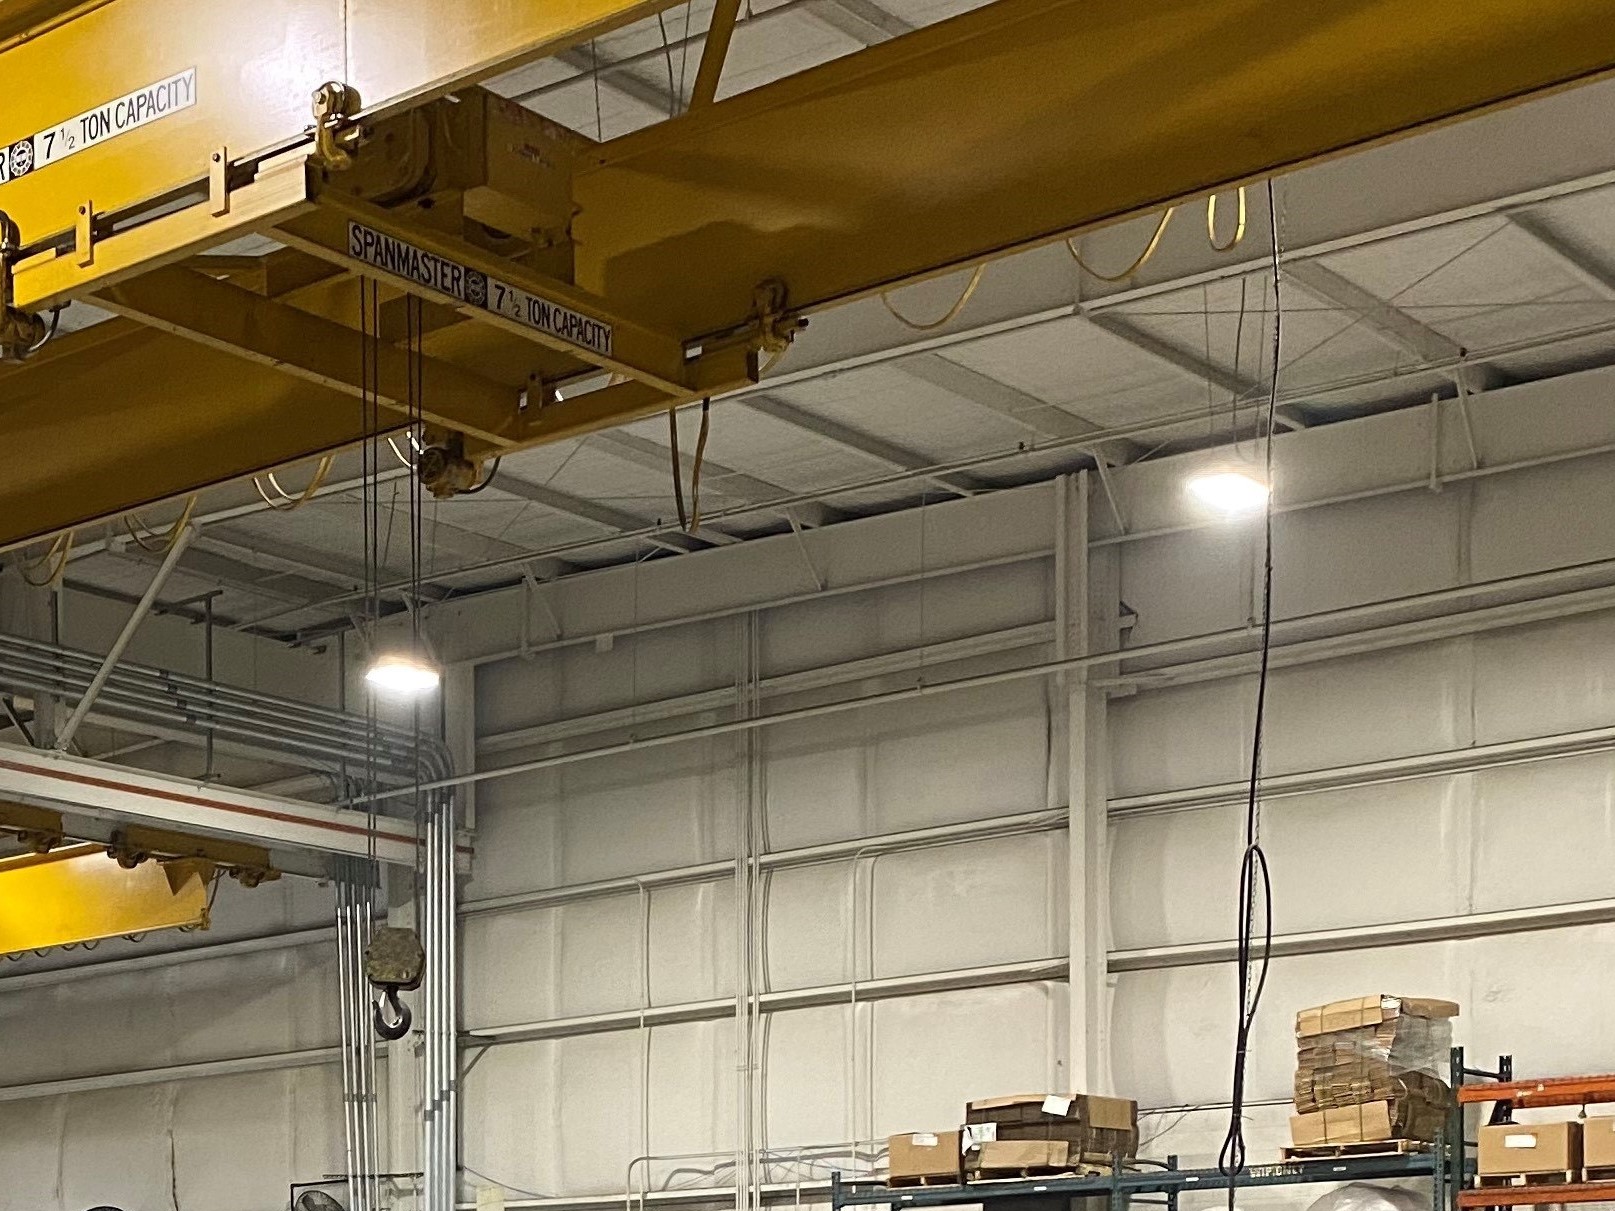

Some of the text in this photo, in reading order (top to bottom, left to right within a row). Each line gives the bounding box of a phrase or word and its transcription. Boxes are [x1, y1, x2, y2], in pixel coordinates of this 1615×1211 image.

[43, 131, 56, 160] 7
[80, 107, 111, 144] TON
[115, 73, 193, 129] CAPACITY
[351, 224, 462, 298] SPANMASTER
[494, 284, 505, 310] 7
[525, 296, 551, 327] TON
[553, 307, 611, 353] CAPACITY
